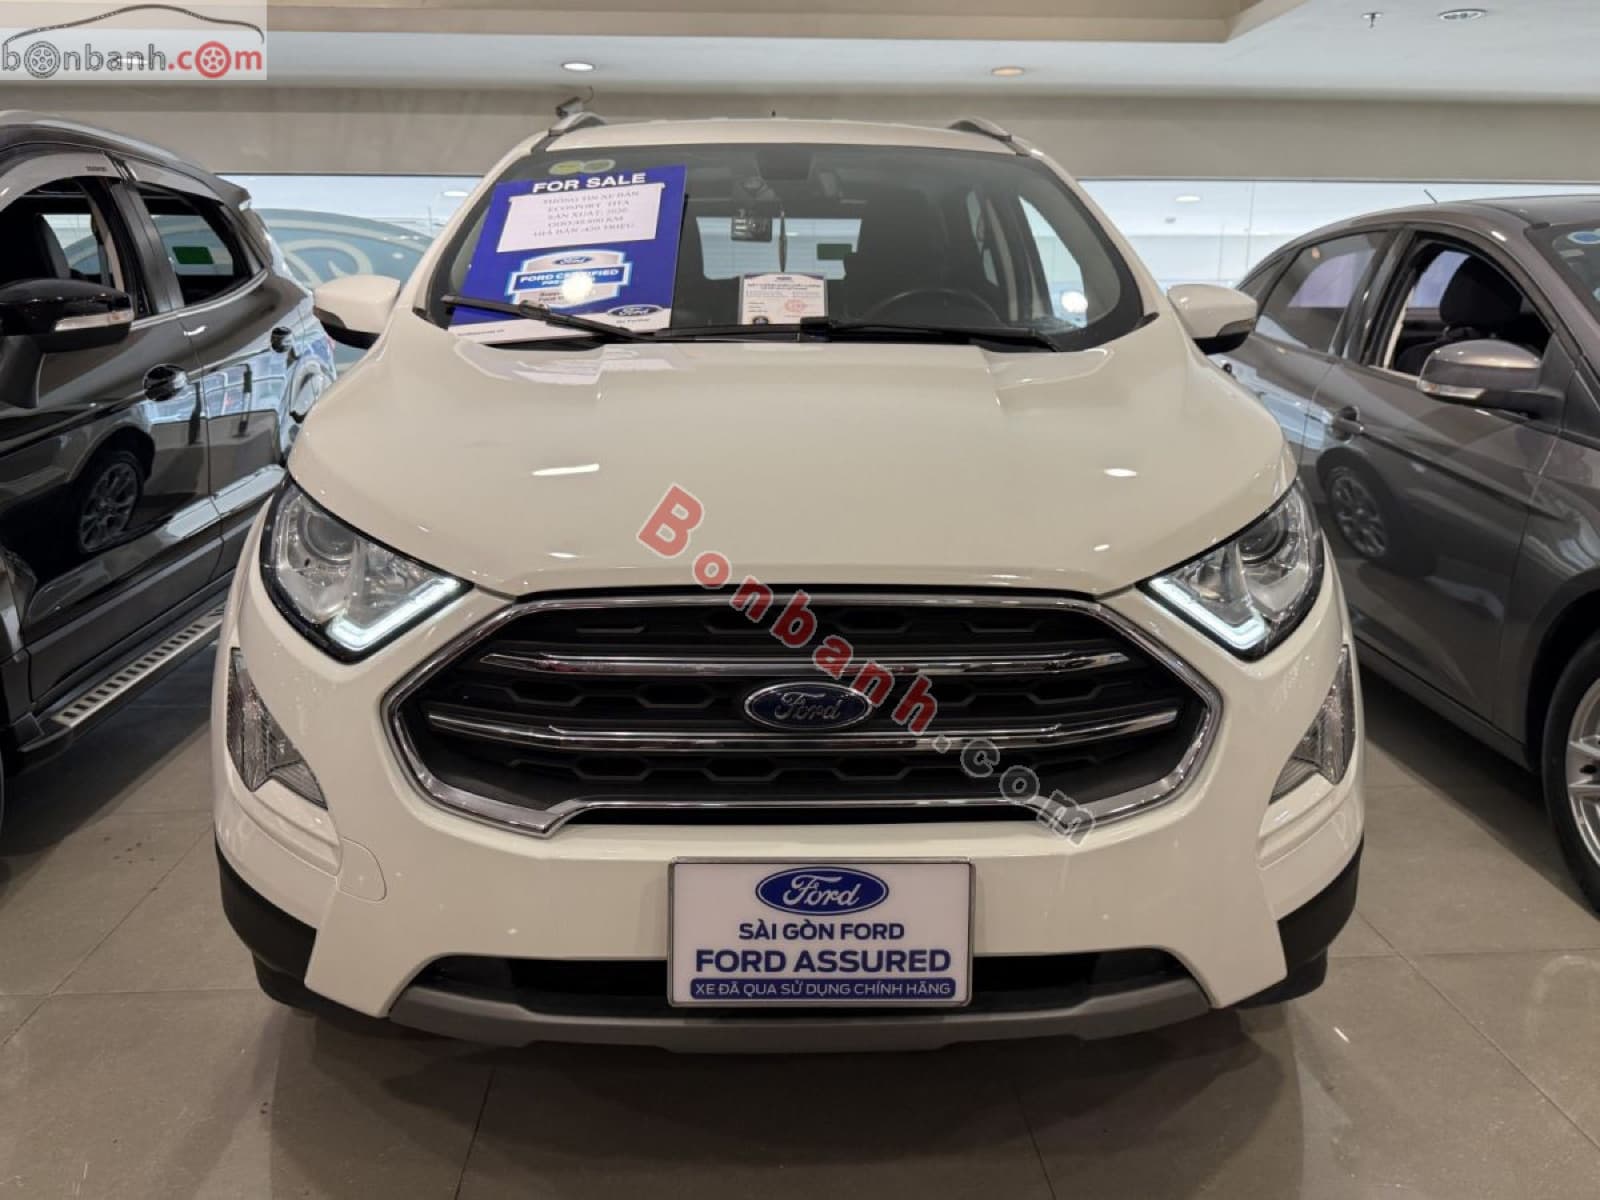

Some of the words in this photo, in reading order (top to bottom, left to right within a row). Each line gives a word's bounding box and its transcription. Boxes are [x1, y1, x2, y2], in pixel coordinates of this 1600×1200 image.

[532, 179, 580, 193] FOR
[587, 173, 646, 188] SALE
[520, 273, 554, 283] FORD
[774, 691, 842, 720] Ford
[782, 874, 860, 906] Ford
[739, 919, 777, 940] SÀI
[783, 919, 834, 940] GÒN
[840, 923, 905, 940] FORD
[695, 949, 786, 973] FORD
[793, 949, 951, 973] ASSURED
[695, 983, 716, 995] XE
[718, 980, 741, 995] ĐÃ
[743, 983, 777, 997] QUA
[781, 979, 802, 995] SỬ
[806, 983, 851, 998] DỤNG
[854, 980, 902, 995] CHÍNH
[906, 980, 951, 995] HÃNG
